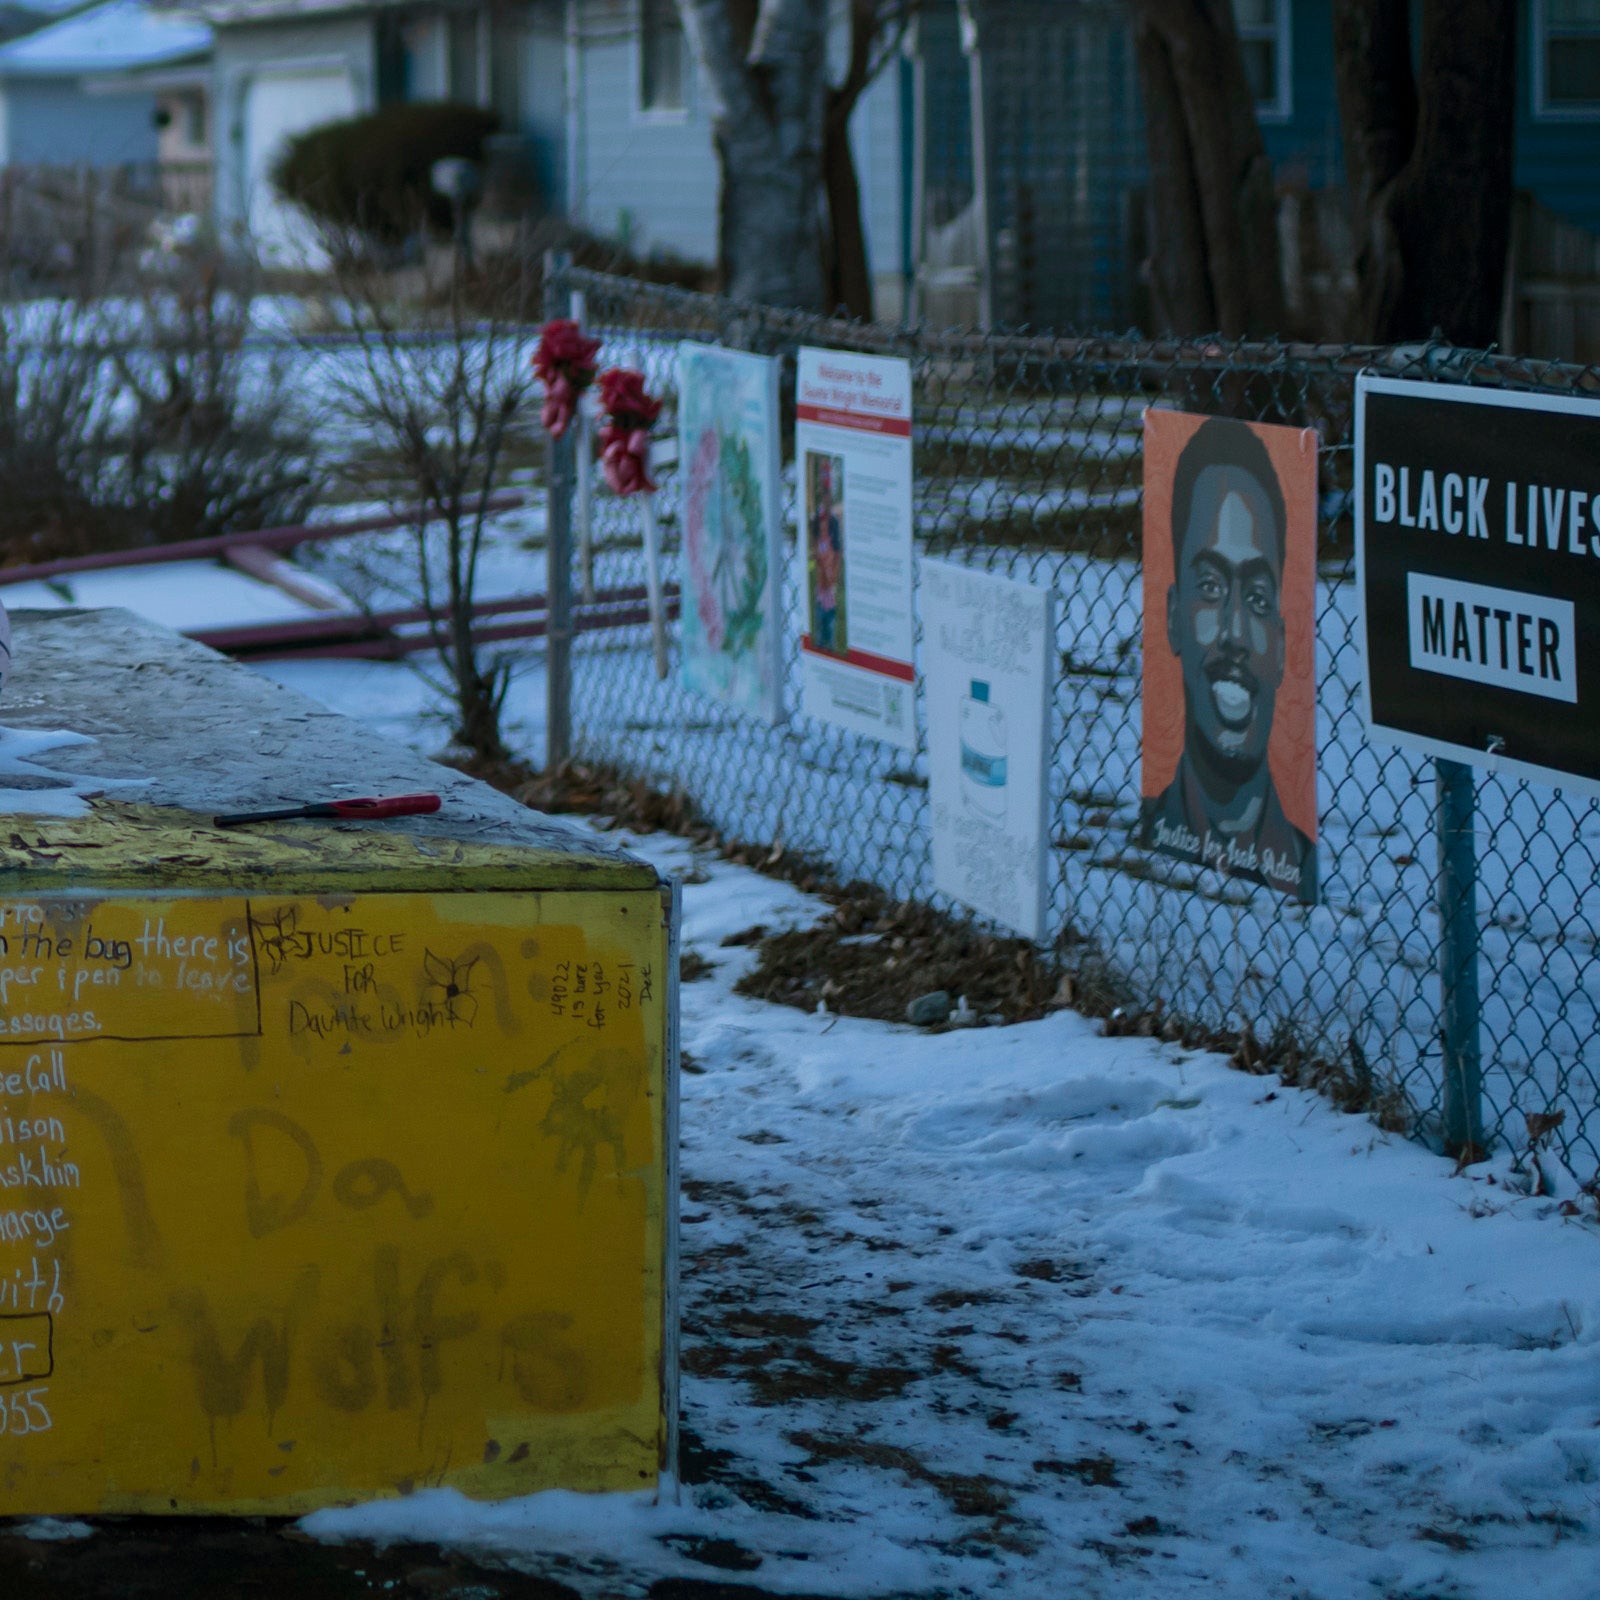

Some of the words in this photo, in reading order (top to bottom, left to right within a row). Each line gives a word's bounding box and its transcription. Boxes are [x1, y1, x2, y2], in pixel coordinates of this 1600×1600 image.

[1375, 463, 1490, 539] BLACK
[1422, 595, 1562, 682] MATTER
[11, 919, 73, 960] the
[84, 923, 133, 971] bag
[135, 916, 218, 960] there
[227, 927, 250, 965] is
[294, 928, 407, 962] JUSTICE
[74, 966, 120, 1001] pen
[343, 962, 378, 995] FOR
[586, 1001, 606, 1030] for
[25, 1049, 67, 1093] Call
[40, 1145, 81, 1189] him
